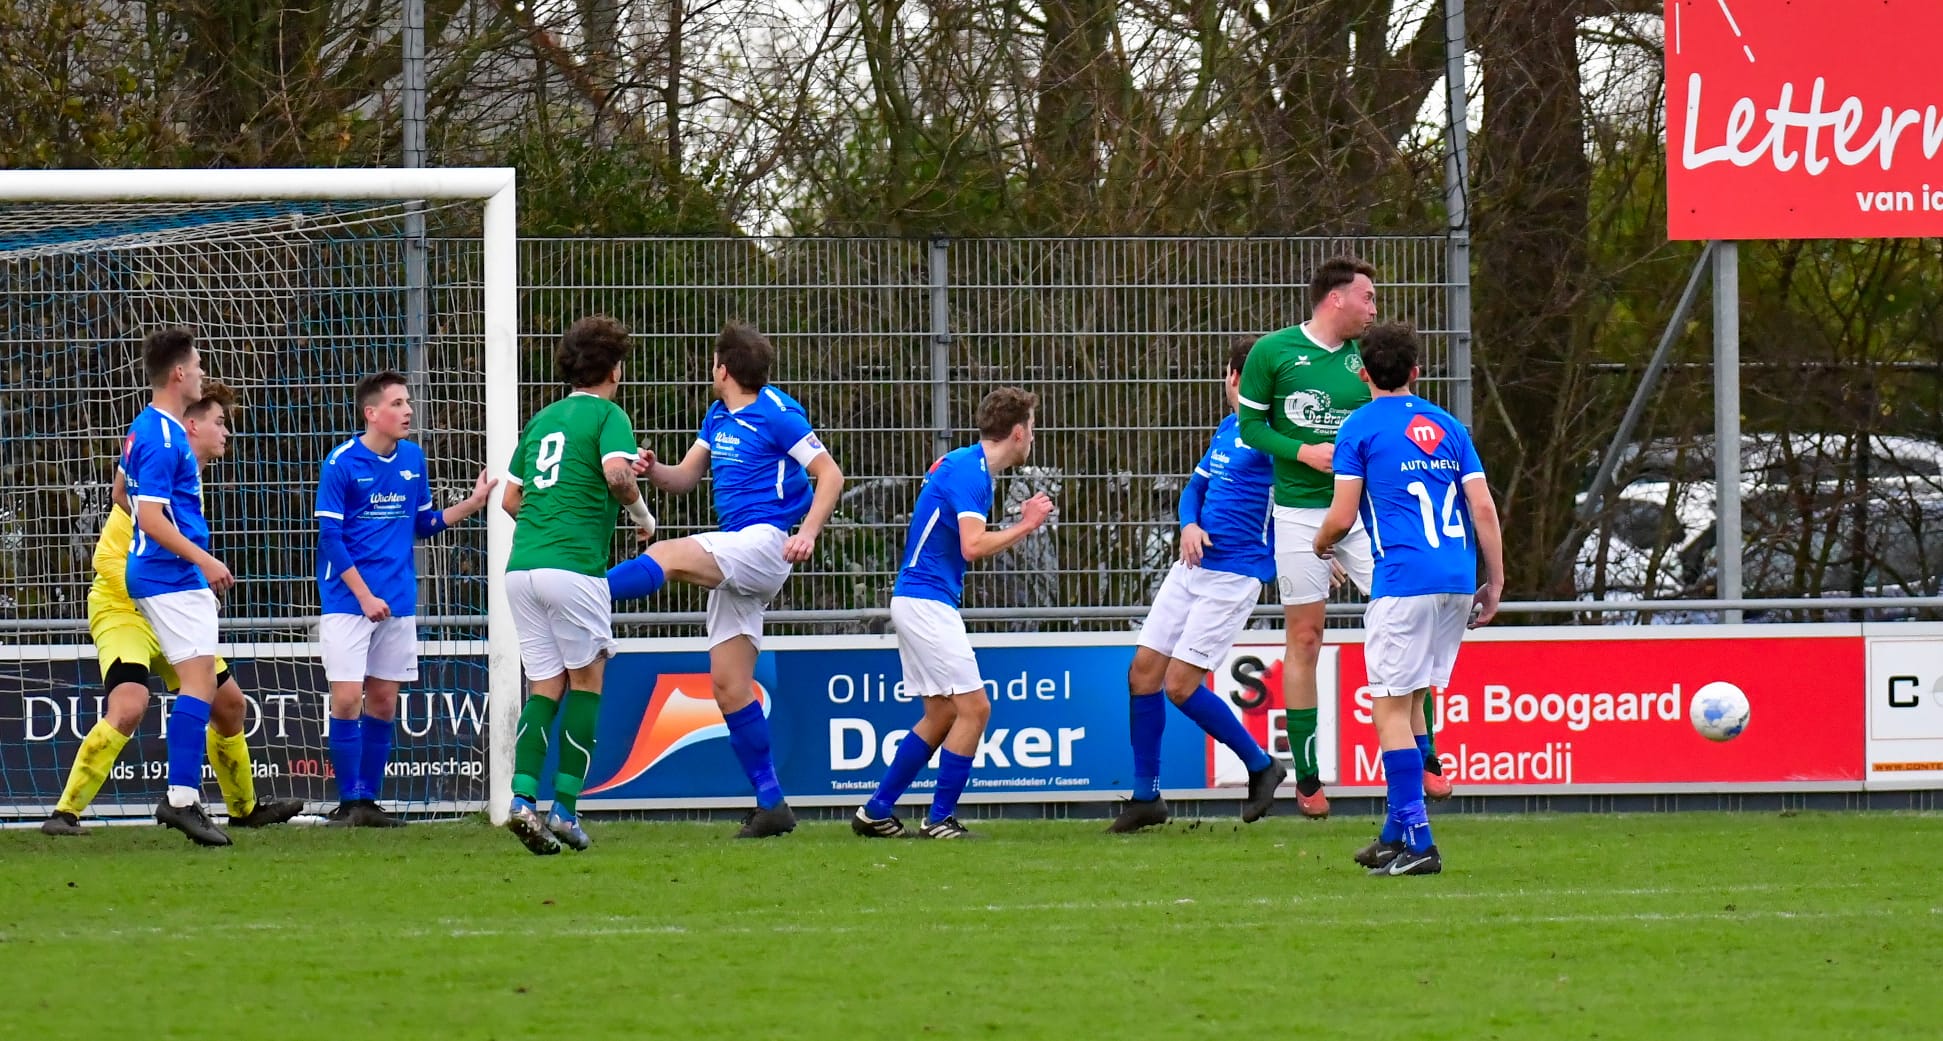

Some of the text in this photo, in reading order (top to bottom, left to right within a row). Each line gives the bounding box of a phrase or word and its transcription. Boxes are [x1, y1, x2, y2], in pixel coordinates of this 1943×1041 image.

[1856, 191, 1914, 211] van
[533, 431, 565, 490] 9
[1400, 460, 1428, 472] AUTO
[1407, 480, 1467, 551] 14
[828, 670, 1070, 703] Oliendel
[1888, 675, 1919, 707] C
[1353, 683, 1681, 732] Sja Boogaard
[829, 717, 1086, 771] Deker
[288, 759, 318, 775] 100
[385, 757, 483, 776] kmanschap
[1354, 742, 1573, 784] Melaardij
[972, 777, 1046, 787] Smeermiddelen
[1055, 776, 1090, 785] Gassen
